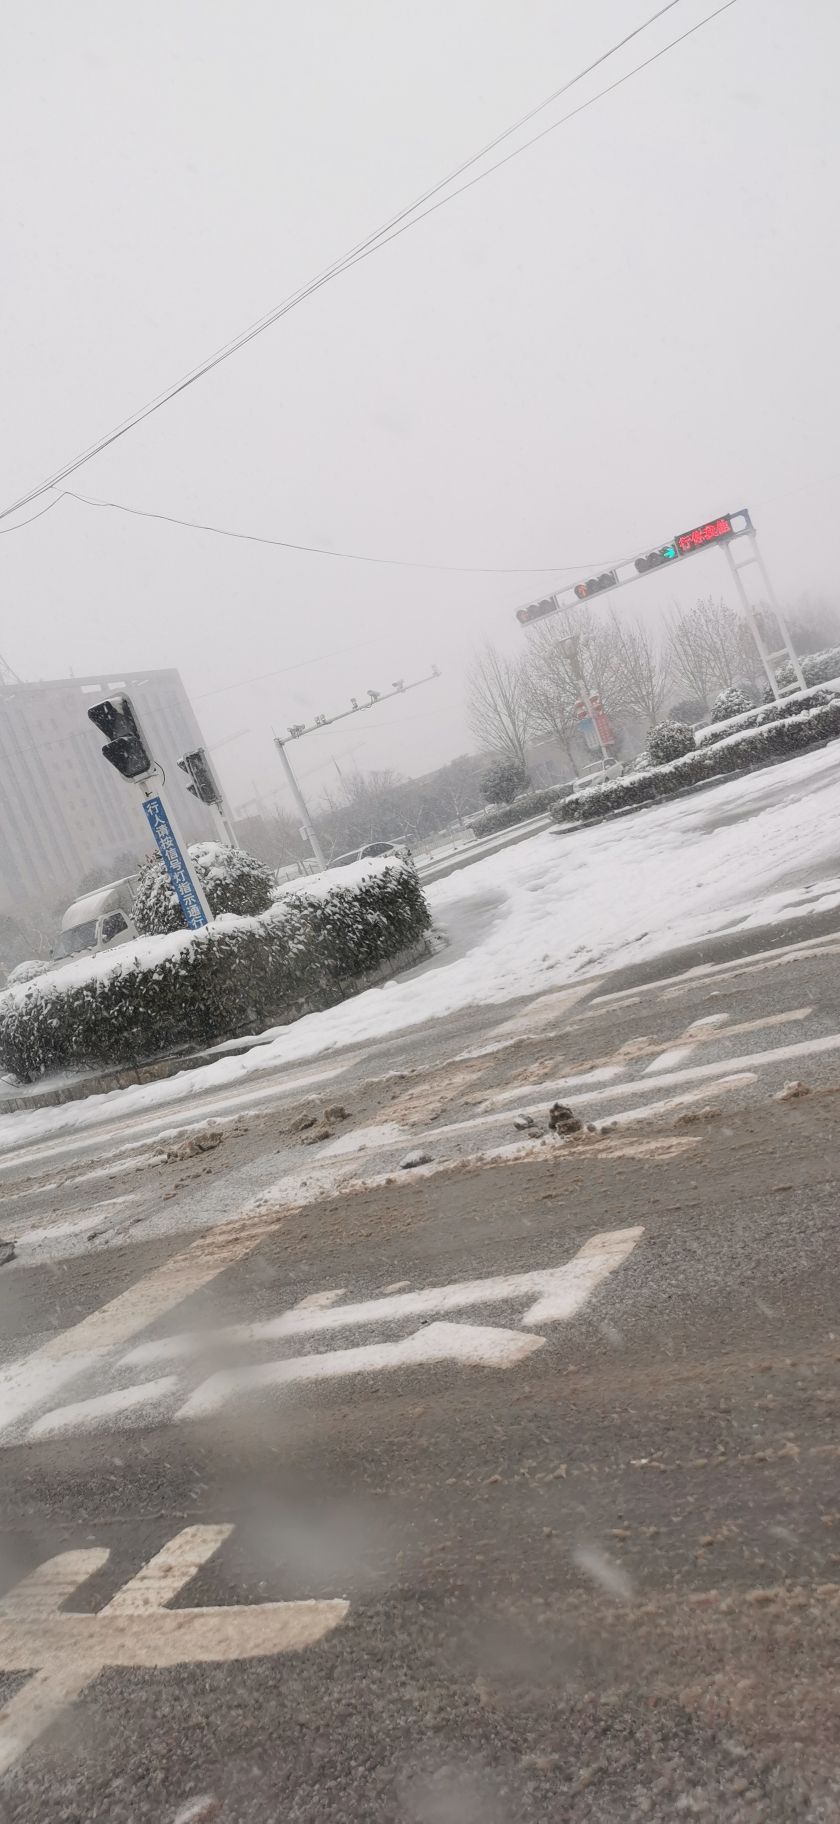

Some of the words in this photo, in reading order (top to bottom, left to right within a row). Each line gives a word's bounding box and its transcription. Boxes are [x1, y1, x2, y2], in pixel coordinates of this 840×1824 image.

[145, 800, 205, 929] 行人请按信号灯指示通行
